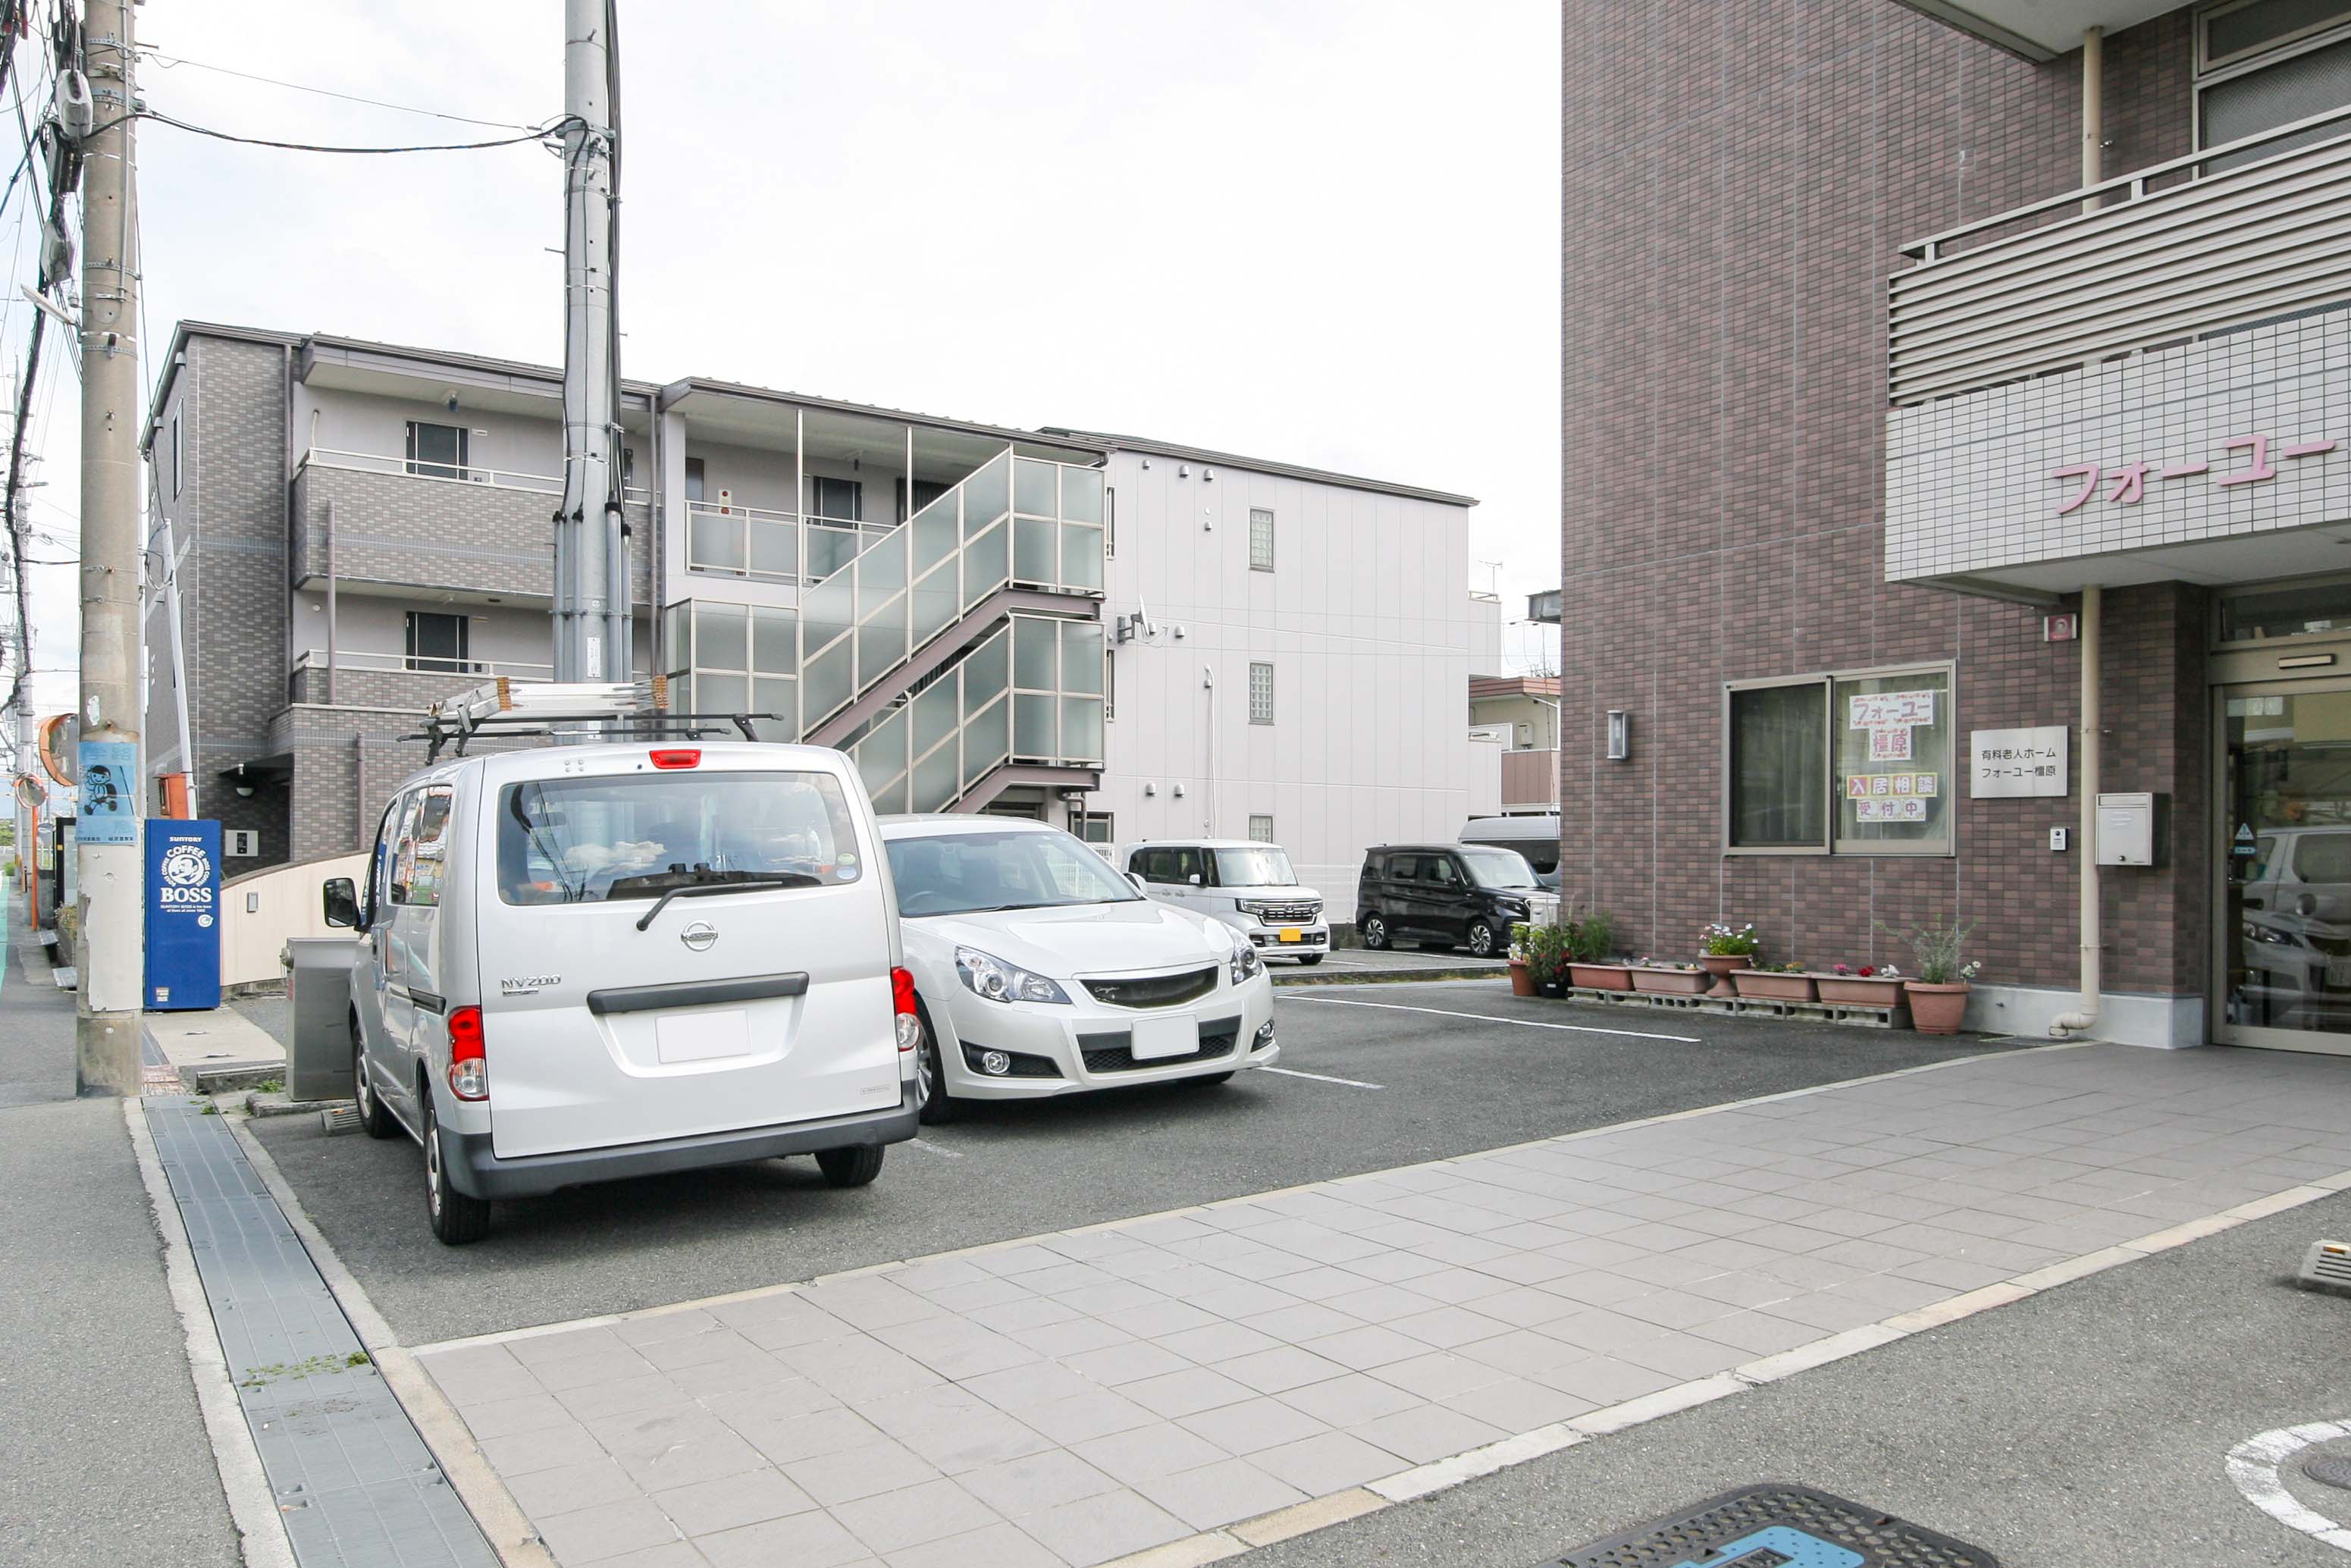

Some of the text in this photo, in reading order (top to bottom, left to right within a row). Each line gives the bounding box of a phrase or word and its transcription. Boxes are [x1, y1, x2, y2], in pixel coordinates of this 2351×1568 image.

[2050, 434, 2337, 516] フォーユー
[1853, 701, 1930, 720] フォーユー
[1981, 747, 2057, 760] 有料老人ホーム
[1981, 764, 2057, 779] フォーユー橿原
[1851, 775, 1935, 795] 入居相談
[1857, 801, 1918, 817] 受付中
[167, 845, 205, 858] COFFEE
[160, 887, 212, 902] BOSS
[501, 974, 561, 989] NV200
